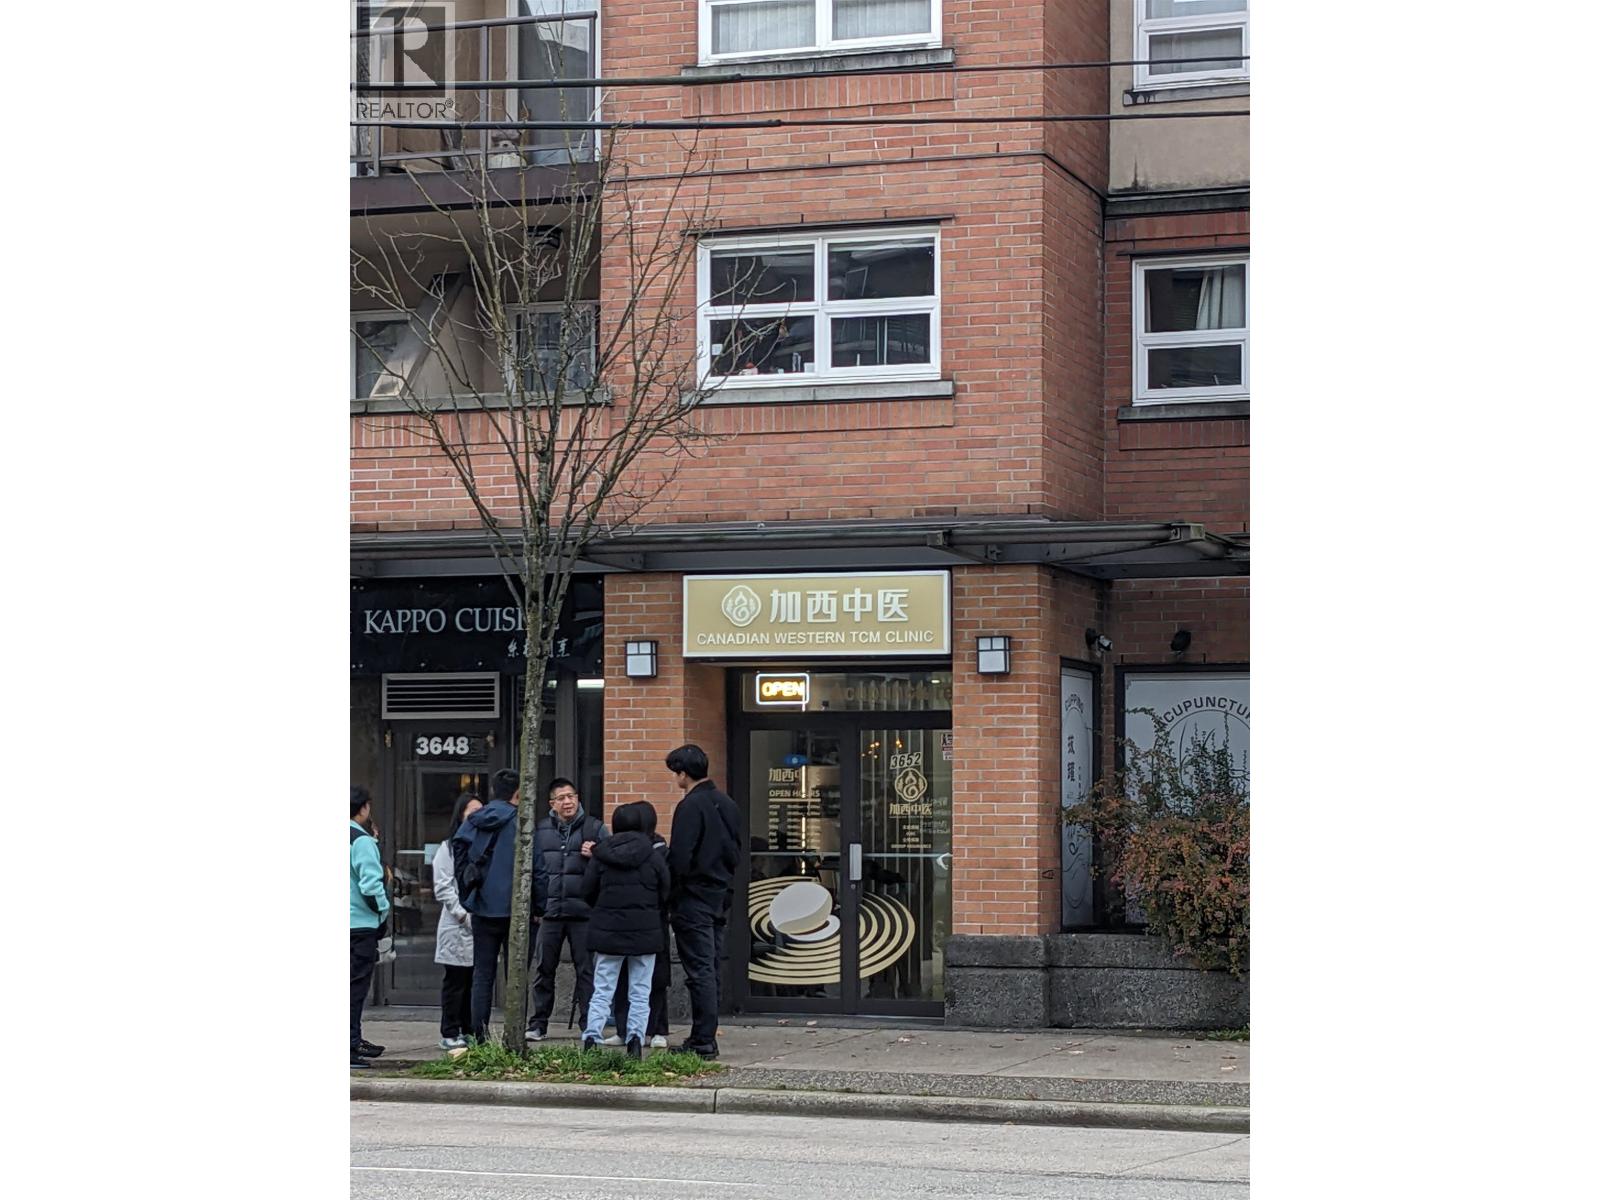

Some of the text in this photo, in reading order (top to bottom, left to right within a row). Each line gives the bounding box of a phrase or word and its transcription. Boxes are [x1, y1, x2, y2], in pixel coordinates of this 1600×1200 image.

[769, 587, 910, 623] 加西中医
[363, 607, 560, 634] KAPPO CUISI
[697, 630, 935, 646] CANADIAN WESTERN TCM CLINIC
[761, 681, 805, 697] OPEN
[415, 736, 470, 755] 3648
[891, 752, 922, 769] 3652
[769, 789, 821, 798] OPEN HRS
[889, 803, 933, 816] 加西中医
